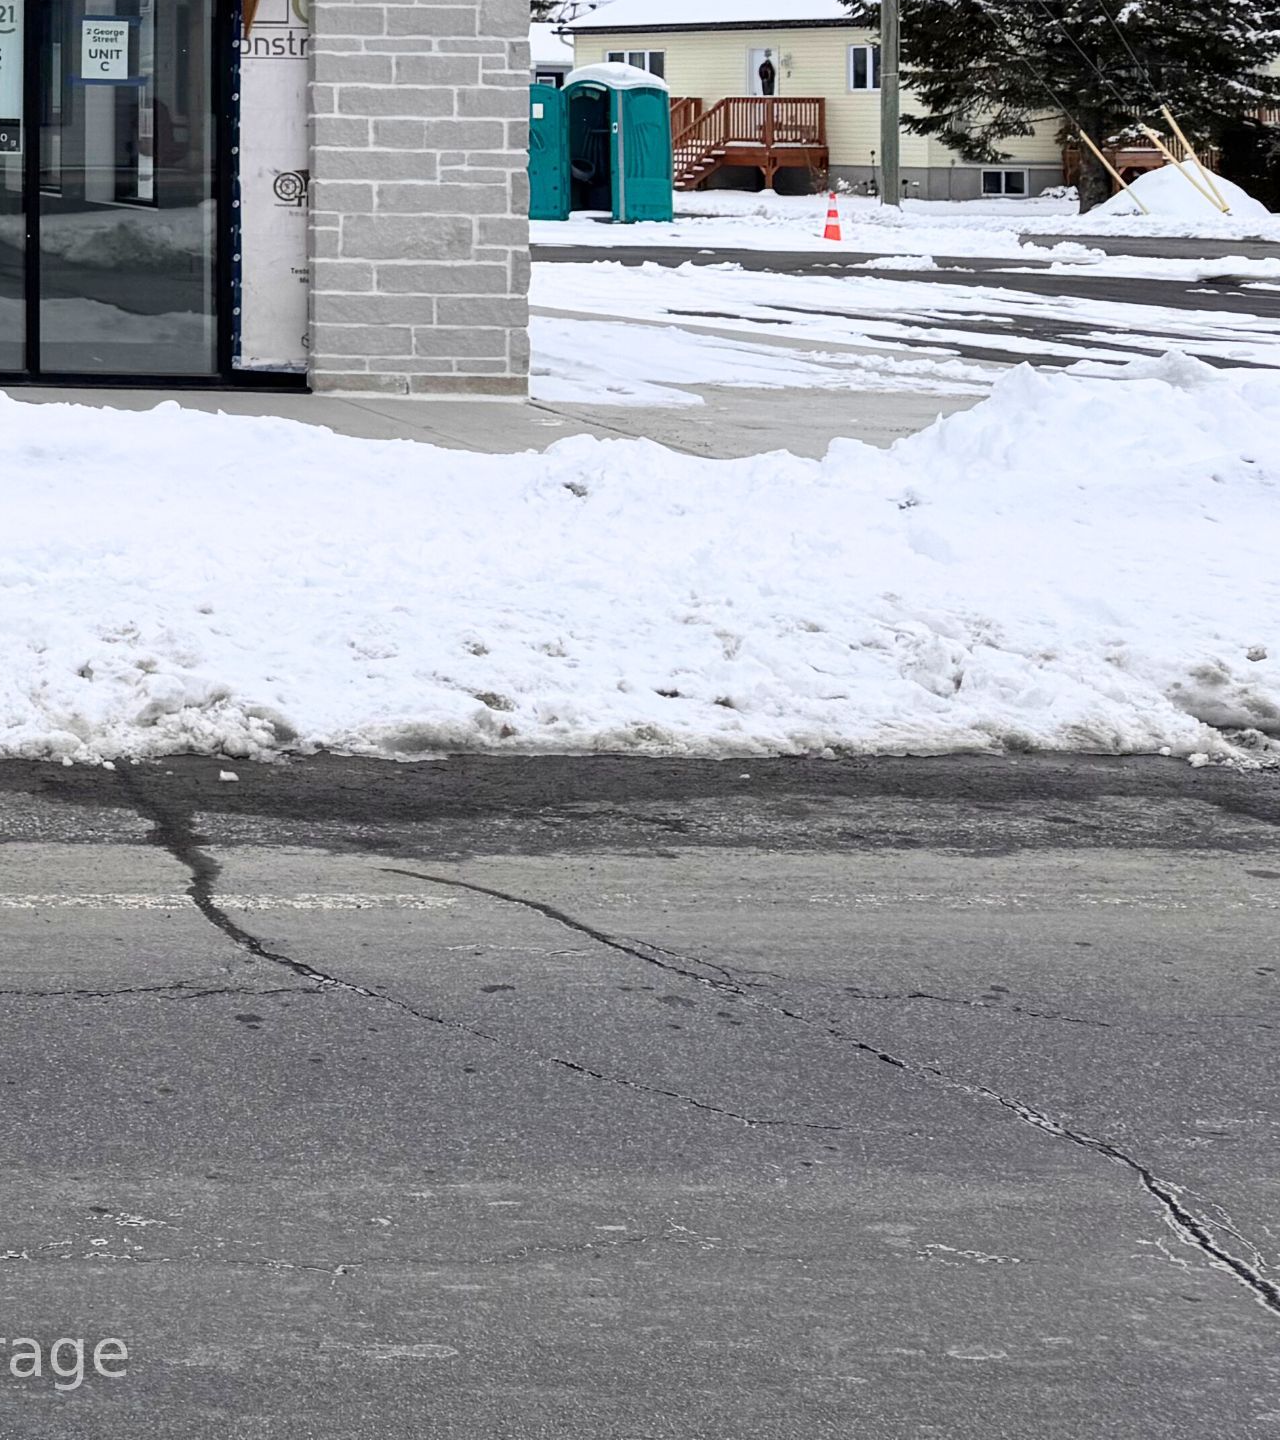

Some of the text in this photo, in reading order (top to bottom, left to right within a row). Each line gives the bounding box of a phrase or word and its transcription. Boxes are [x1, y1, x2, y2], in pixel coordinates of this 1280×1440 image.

[93, 28, 124, 36] George
[88, 49, 123, 60] UNIT
[100, 61, 110, 72] C
